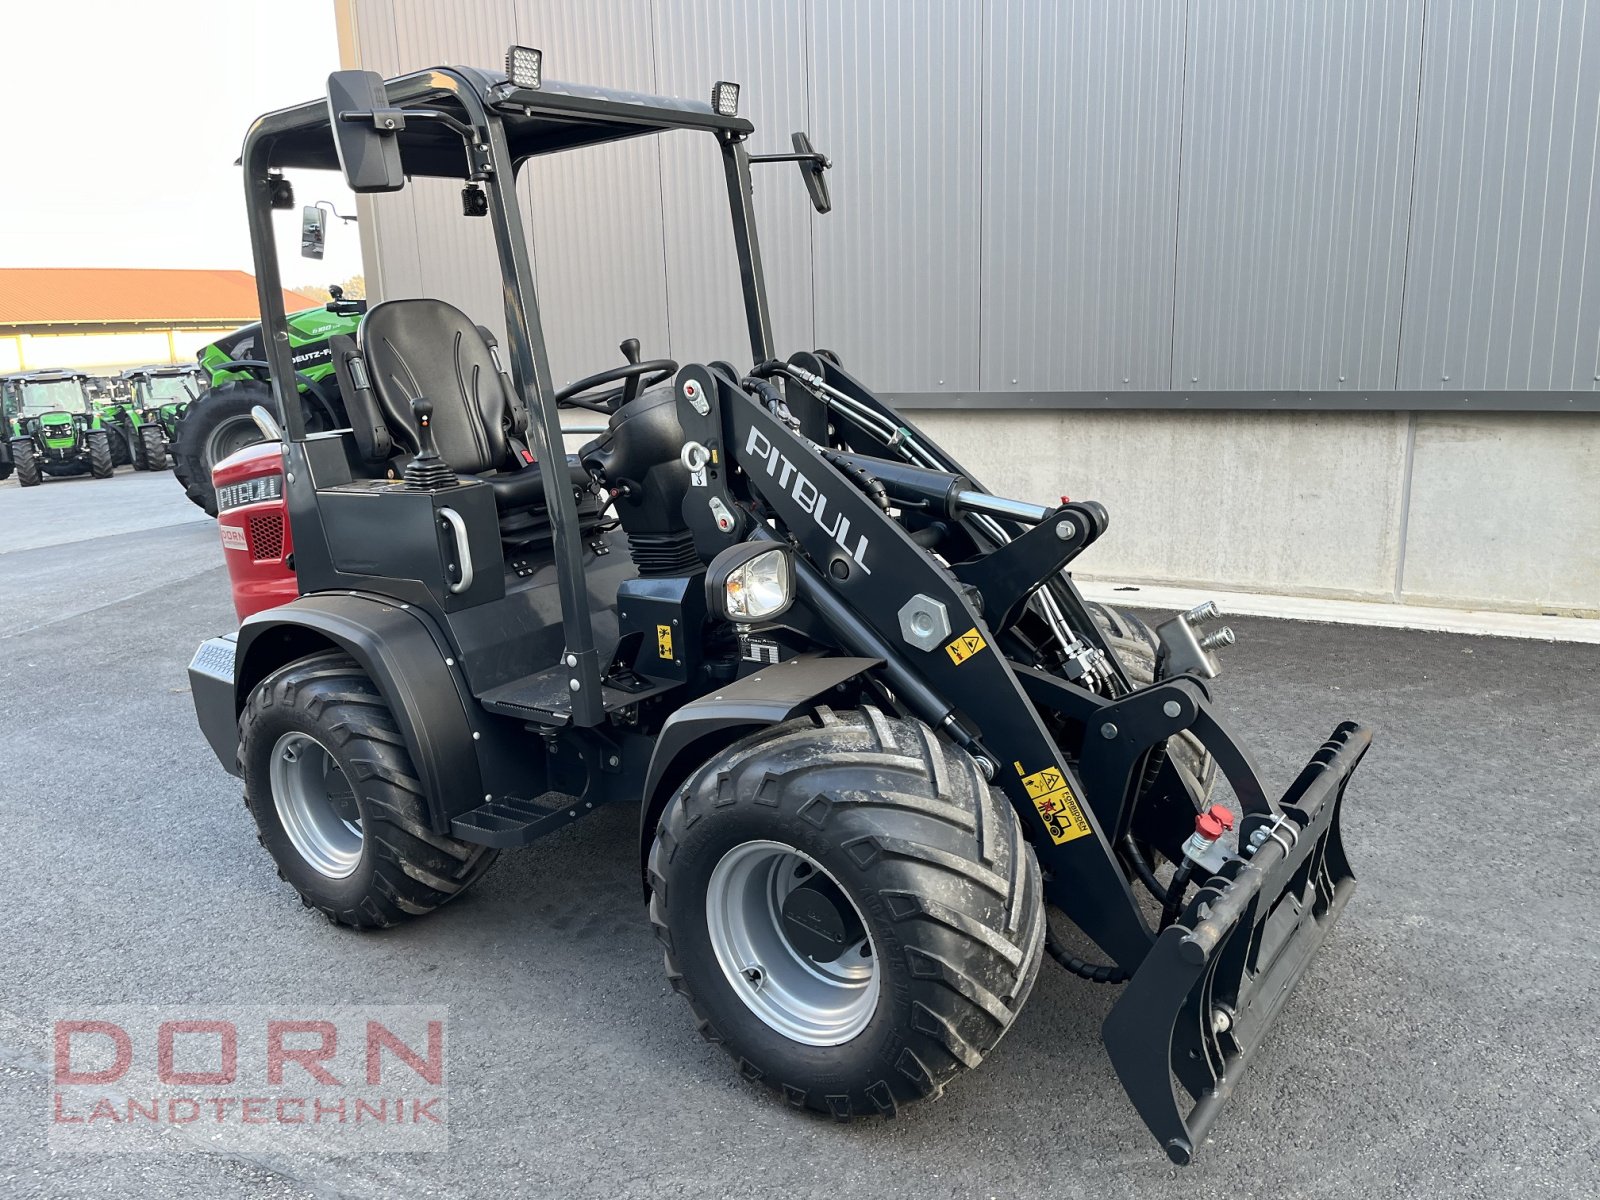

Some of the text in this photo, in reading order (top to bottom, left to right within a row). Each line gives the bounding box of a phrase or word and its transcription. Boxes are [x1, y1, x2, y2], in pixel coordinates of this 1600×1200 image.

[292, 348, 332, 364] DEUTZ-F
[220, 478, 281, 508] PITBULL
[746, 425, 872, 576] PITBULL
[1064, 791, 1088, 831] FORBIDDEN
